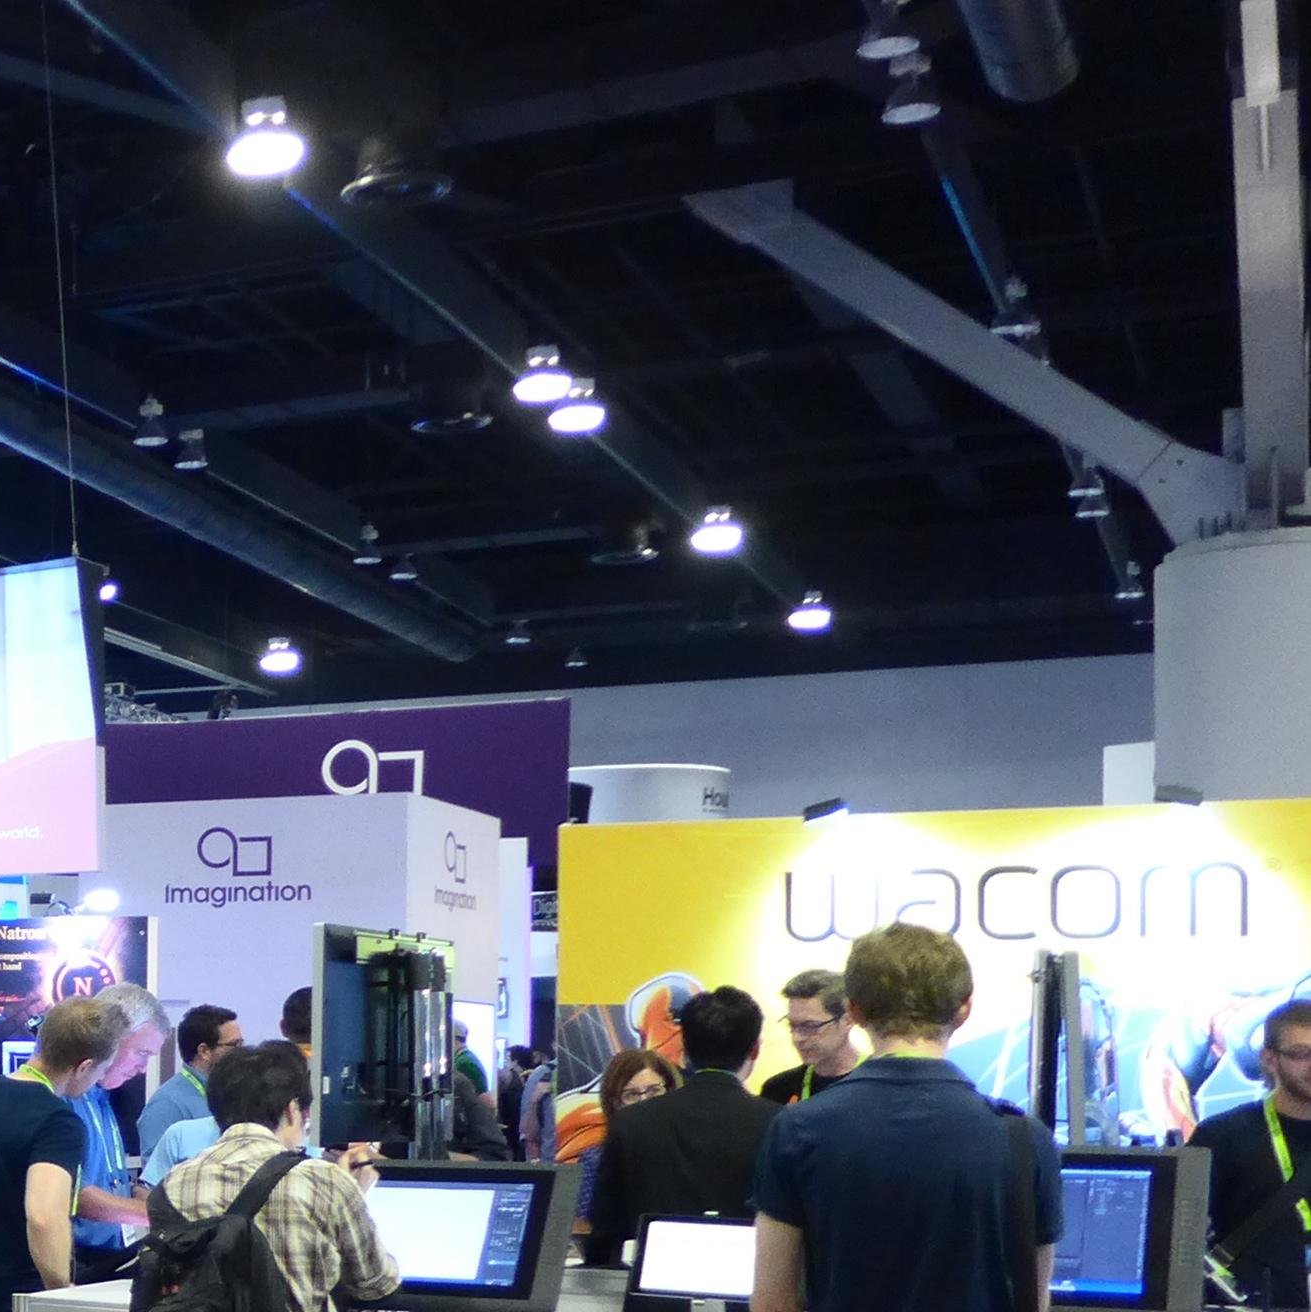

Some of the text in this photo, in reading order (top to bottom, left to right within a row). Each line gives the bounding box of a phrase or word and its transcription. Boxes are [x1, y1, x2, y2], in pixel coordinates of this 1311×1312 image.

[164, 881, 312, 908] Imagination
[784, 862, 1249, 942] wacom
[73, 977, 93, 996] N
